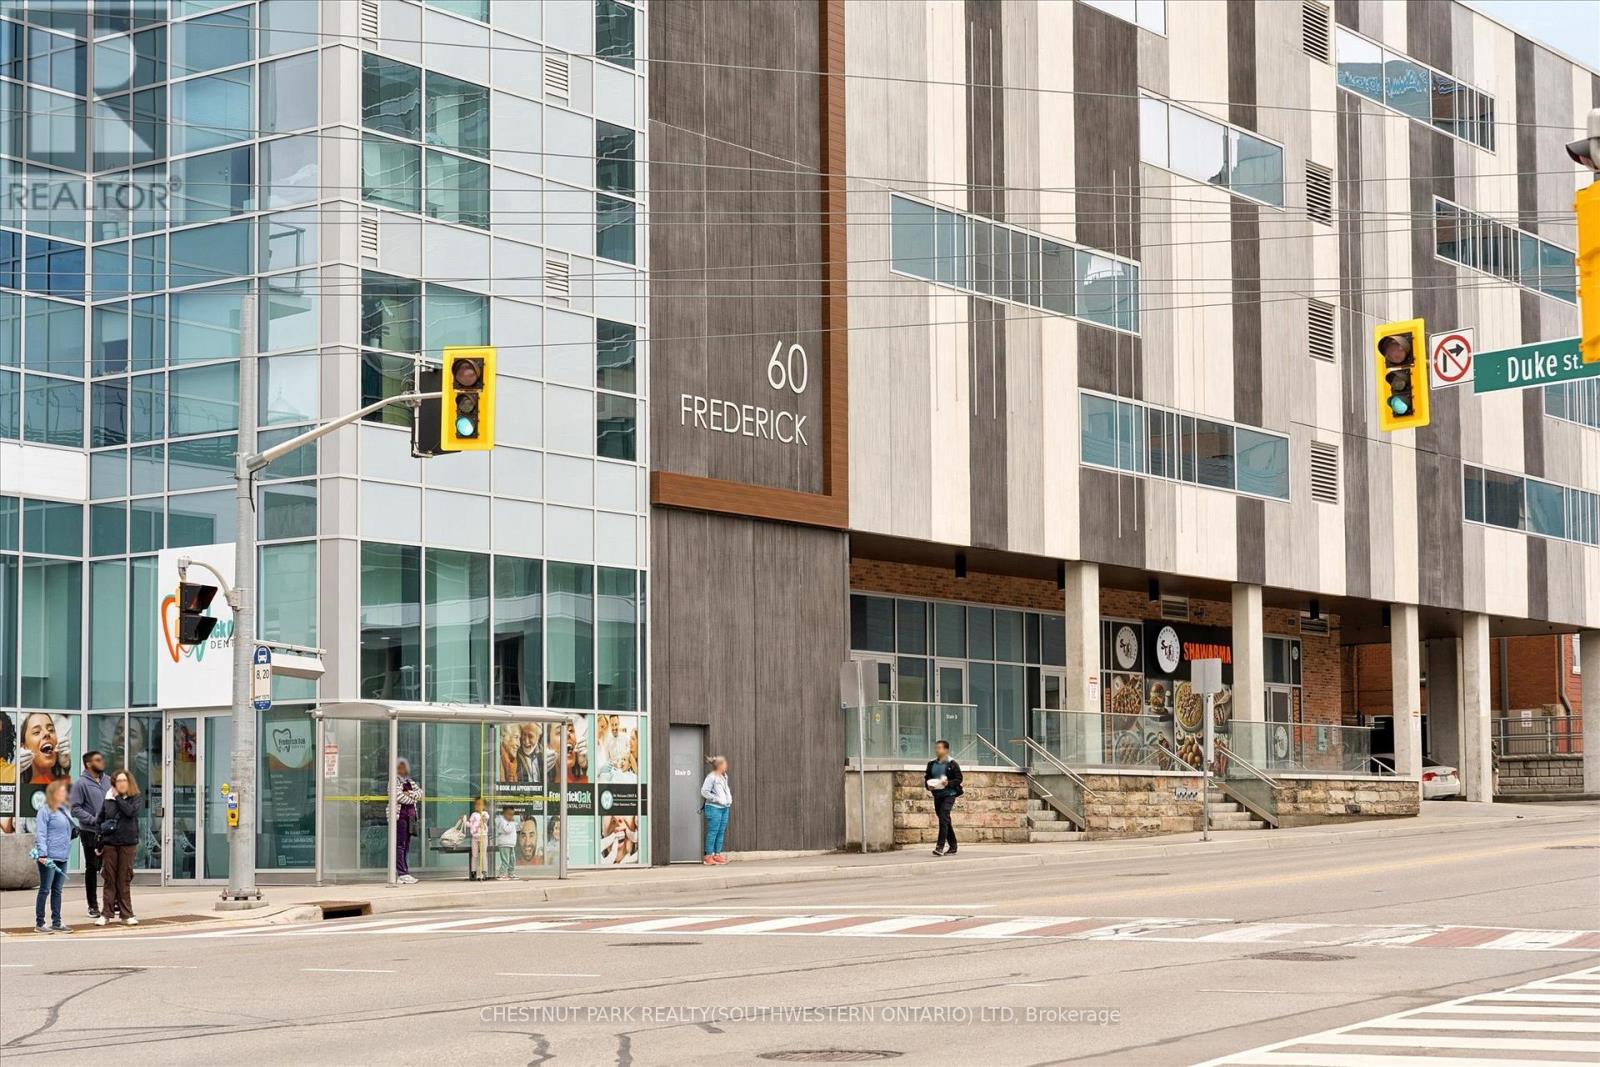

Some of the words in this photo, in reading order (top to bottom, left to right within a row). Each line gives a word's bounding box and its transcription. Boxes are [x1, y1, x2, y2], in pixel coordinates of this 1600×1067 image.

[767, 340, 808, 394] 60
[1507, 351, 1558, 383] Duke
[681, 393, 808, 446] FREDERICK
[1183, 642, 1232, 665] SHAWARMA
[262, 669, 269, 679] 20
